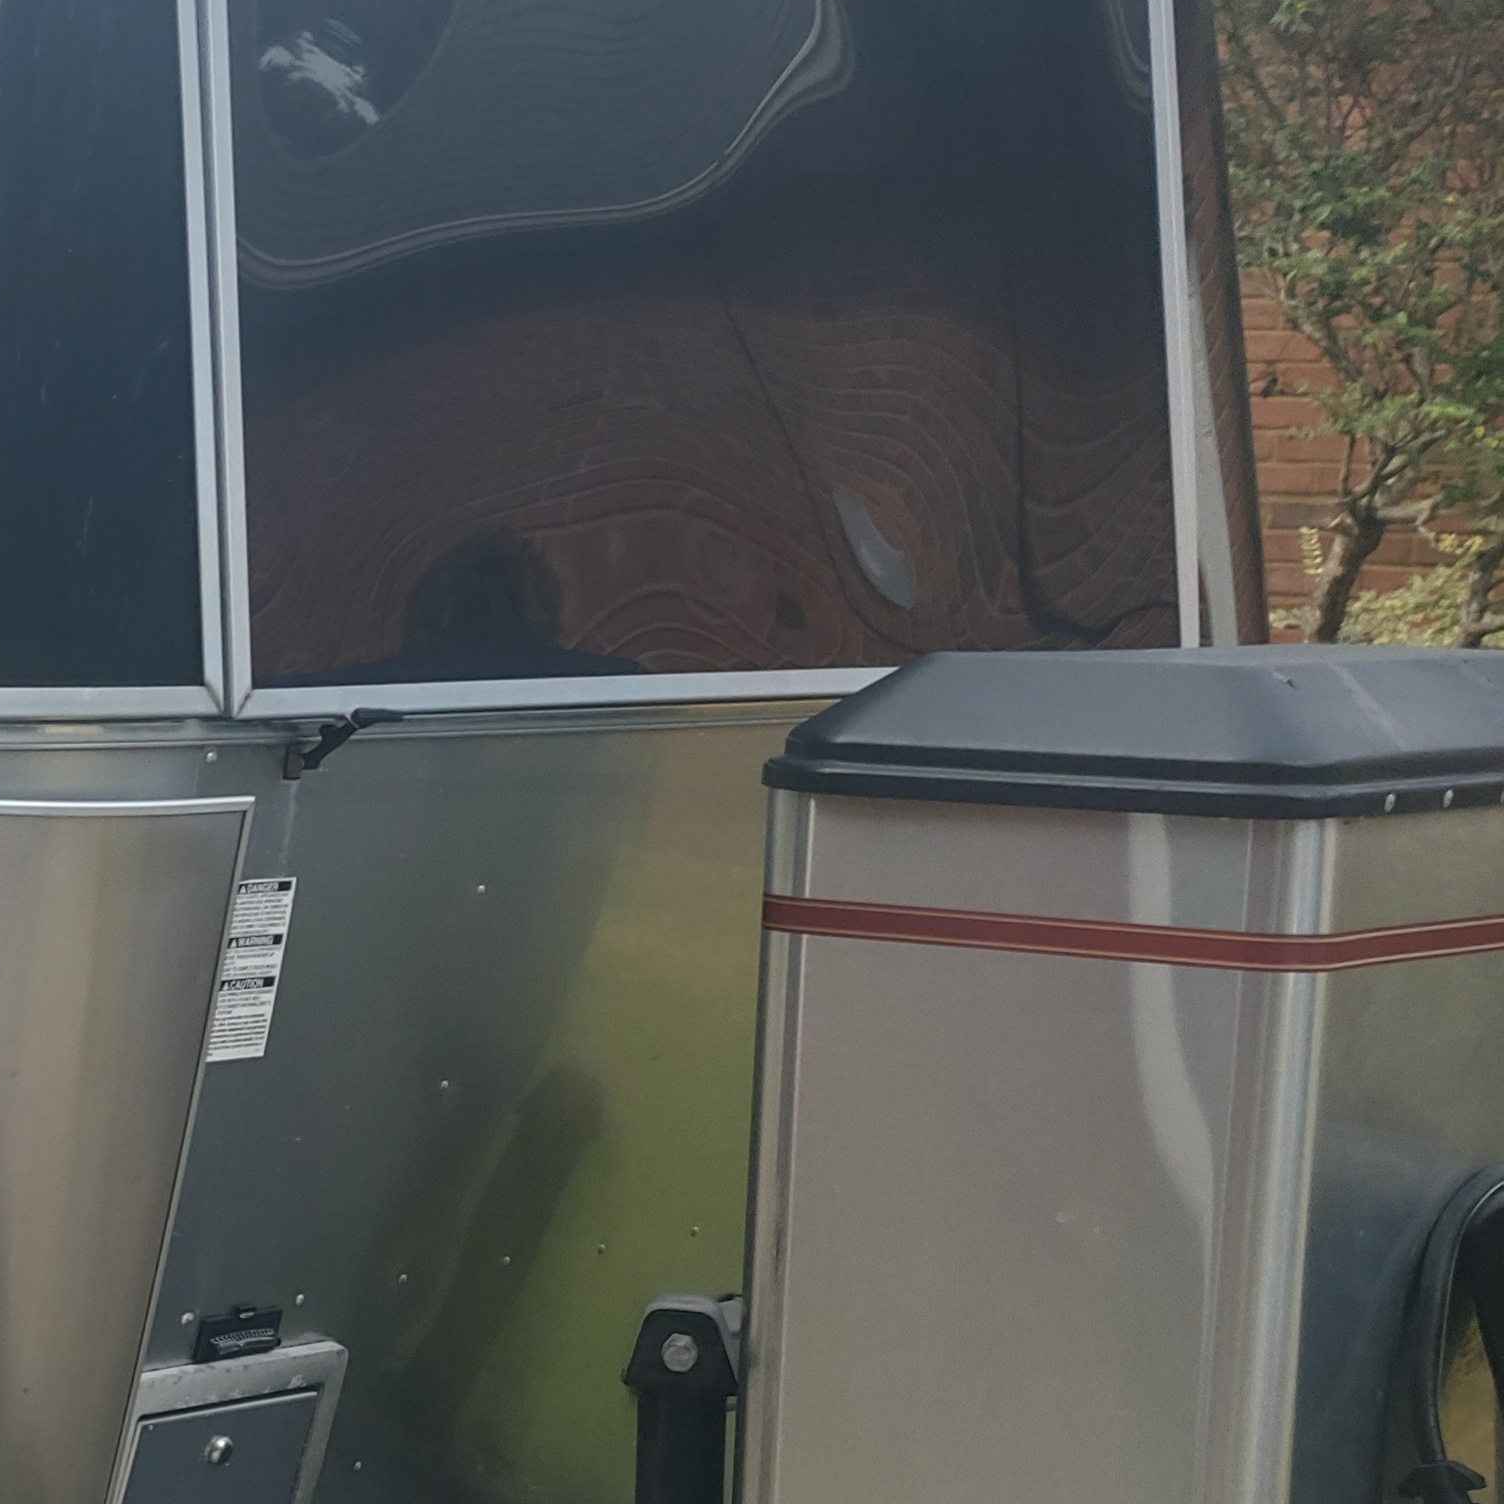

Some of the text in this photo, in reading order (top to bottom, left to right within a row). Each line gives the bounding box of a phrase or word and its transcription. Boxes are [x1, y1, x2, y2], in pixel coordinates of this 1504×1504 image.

[247, 882, 278, 893] DANGER
[238, 935, 274, 946] WARNING
[229, 979, 264, 990] CAUTION
